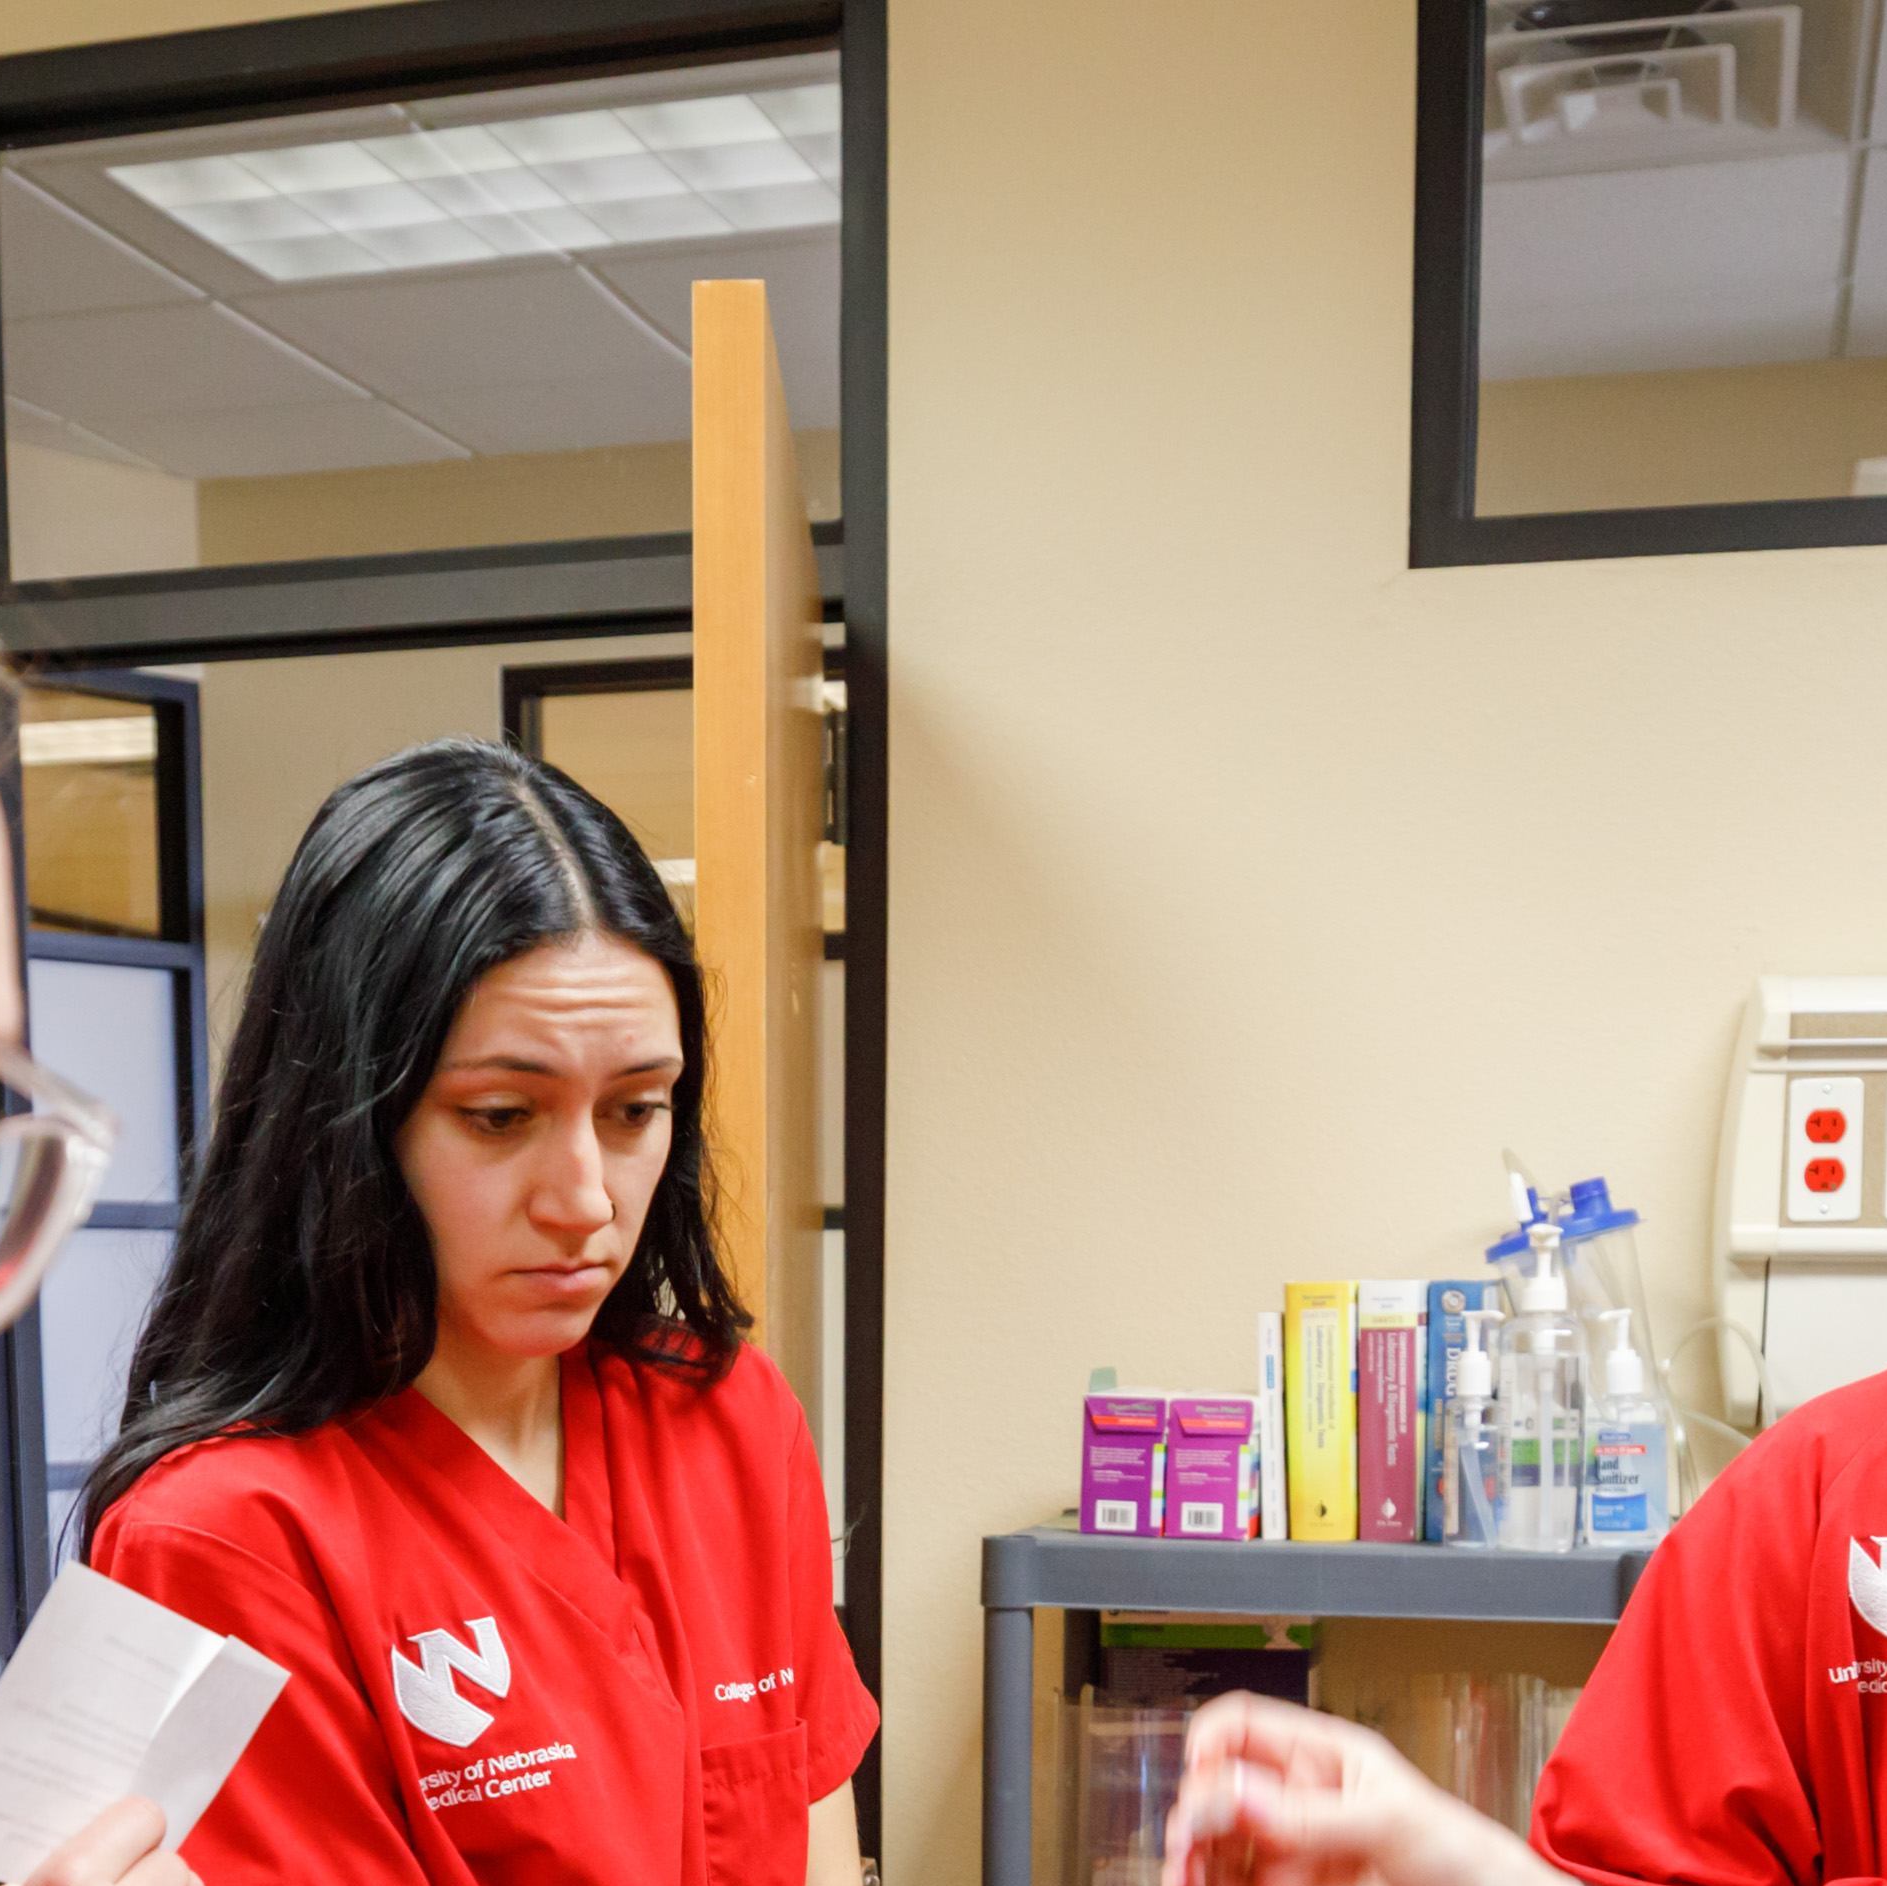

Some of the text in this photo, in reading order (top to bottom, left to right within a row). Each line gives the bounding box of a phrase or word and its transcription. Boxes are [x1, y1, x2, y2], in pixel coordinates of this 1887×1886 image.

[1385, 1332, 1398, 1382] Laboratory
[1385, 1393, 1398, 1441] Diagnostic
[1387, 1443, 1399, 1466] Tests
[714, 1682, 757, 1703] College
[758, 1672, 776, 1692] of
[419, 1742, 577, 1792] rsity of Nebraska
[425, 1770, 552, 1811] edical Center
